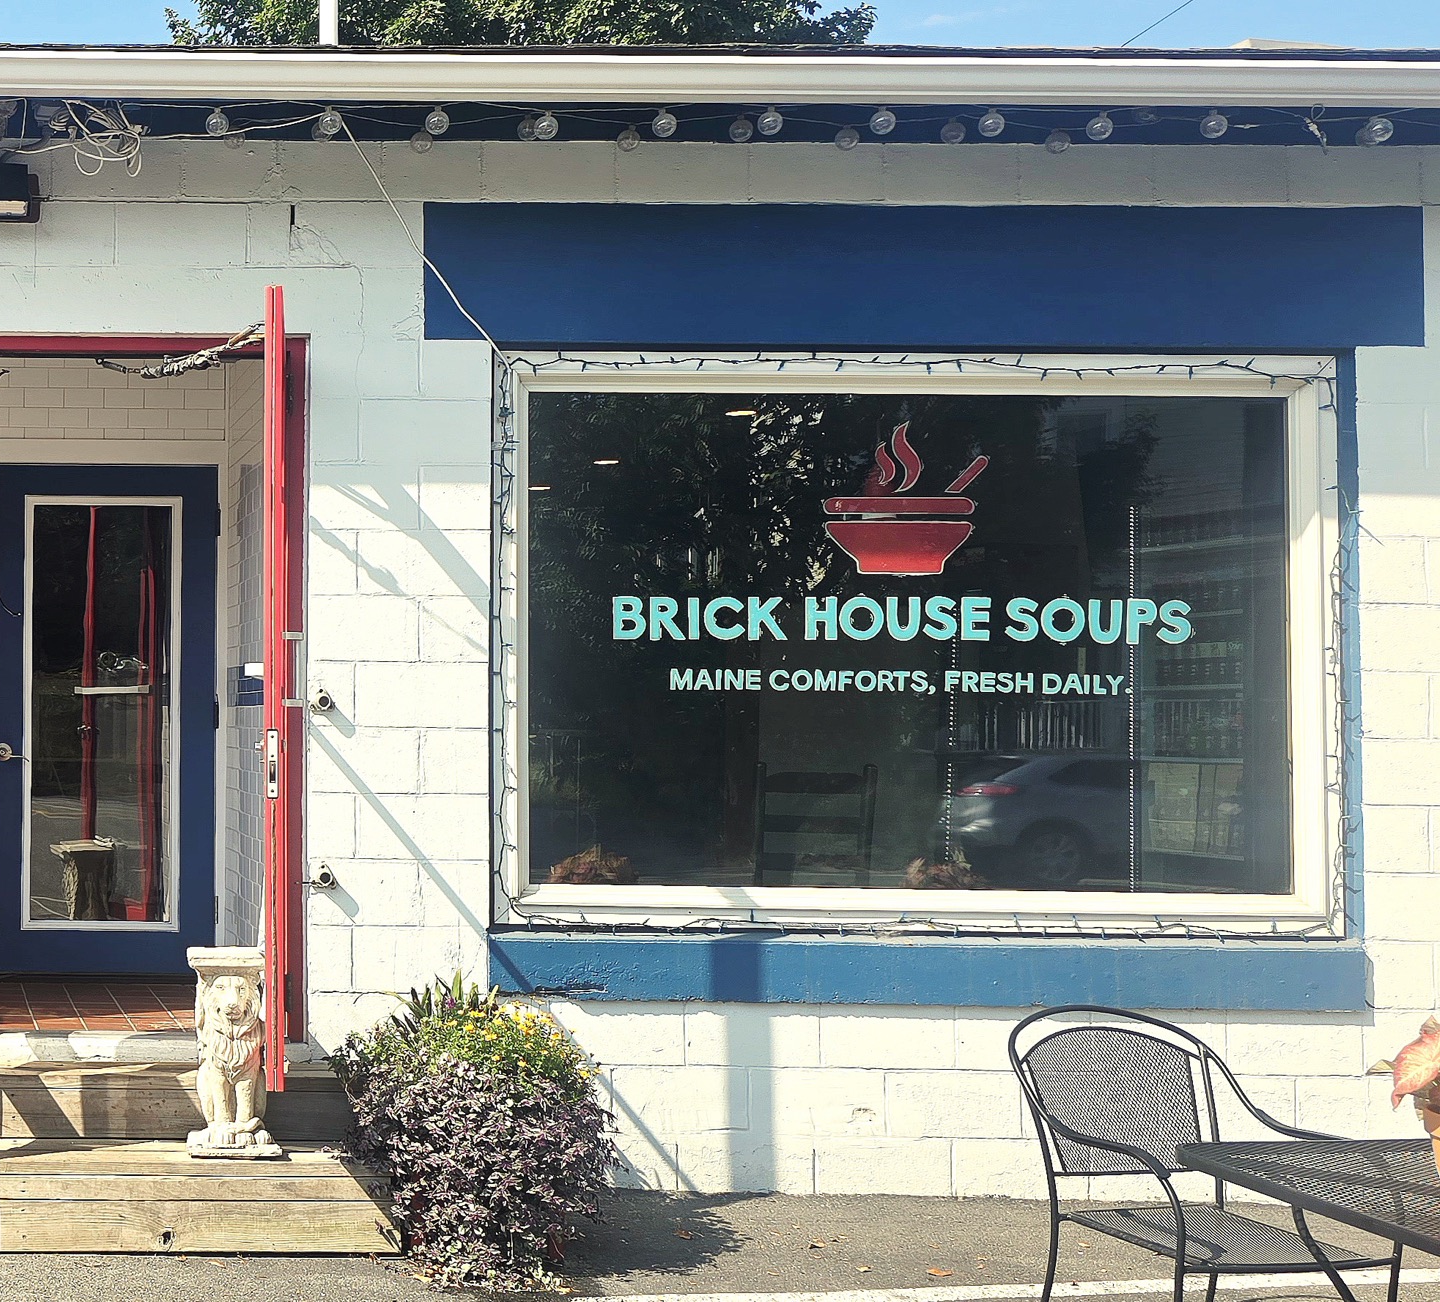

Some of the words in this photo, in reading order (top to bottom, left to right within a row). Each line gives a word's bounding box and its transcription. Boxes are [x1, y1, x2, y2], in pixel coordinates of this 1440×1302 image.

[612, 595, 788, 641] BRICK
[804, 595, 992, 642] HOUSE
[1005, 596, 1192, 645] SOUPS
[669, 668, 761, 691] MAINE
[768, 669, 936, 695] COMFORTS,
[944, 670, 1034, 694] FRESH
[1042, 673, 1133, 695] DAILY.
